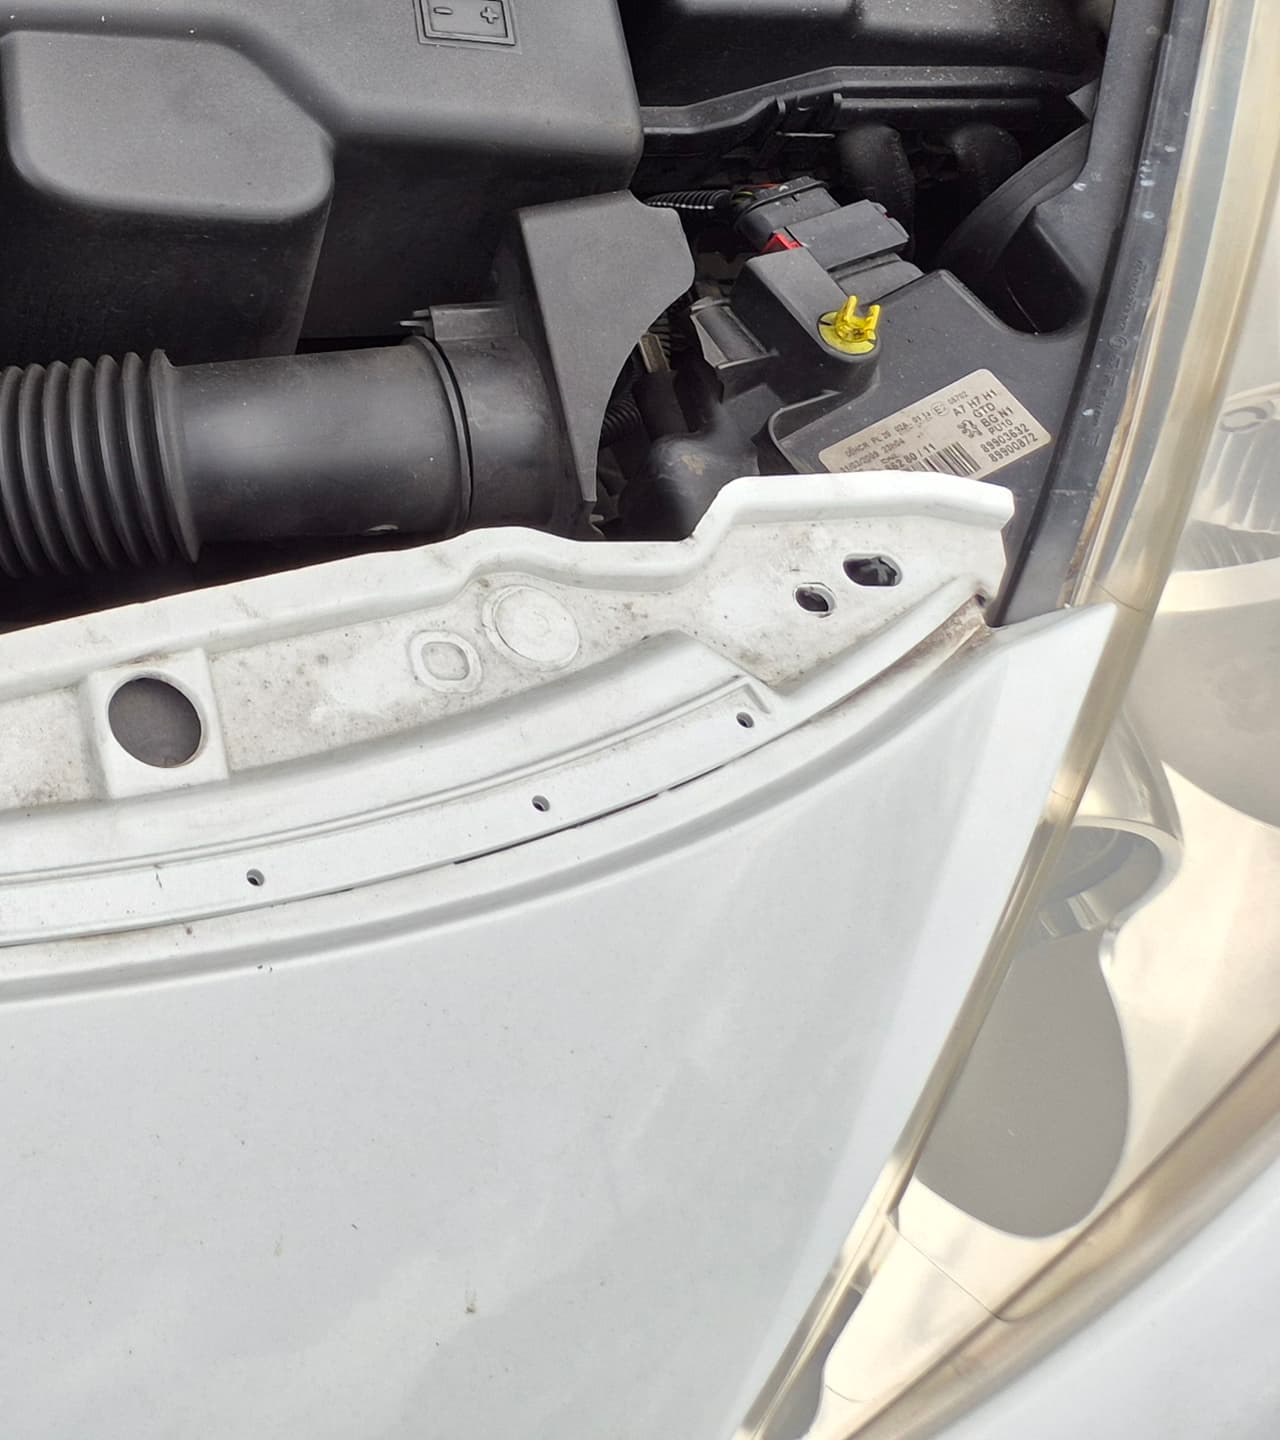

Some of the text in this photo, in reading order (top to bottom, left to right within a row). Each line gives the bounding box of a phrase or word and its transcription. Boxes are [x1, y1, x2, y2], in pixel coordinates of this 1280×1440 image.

[953, 389, 997, 416] A7 H7 H1
[973, 402, 995, 418] GTD
[980, 406, 1014, 427] BG N1
[988, 419, 1013, 435] PU10
[980, 423, 1030, 453] 89903632
